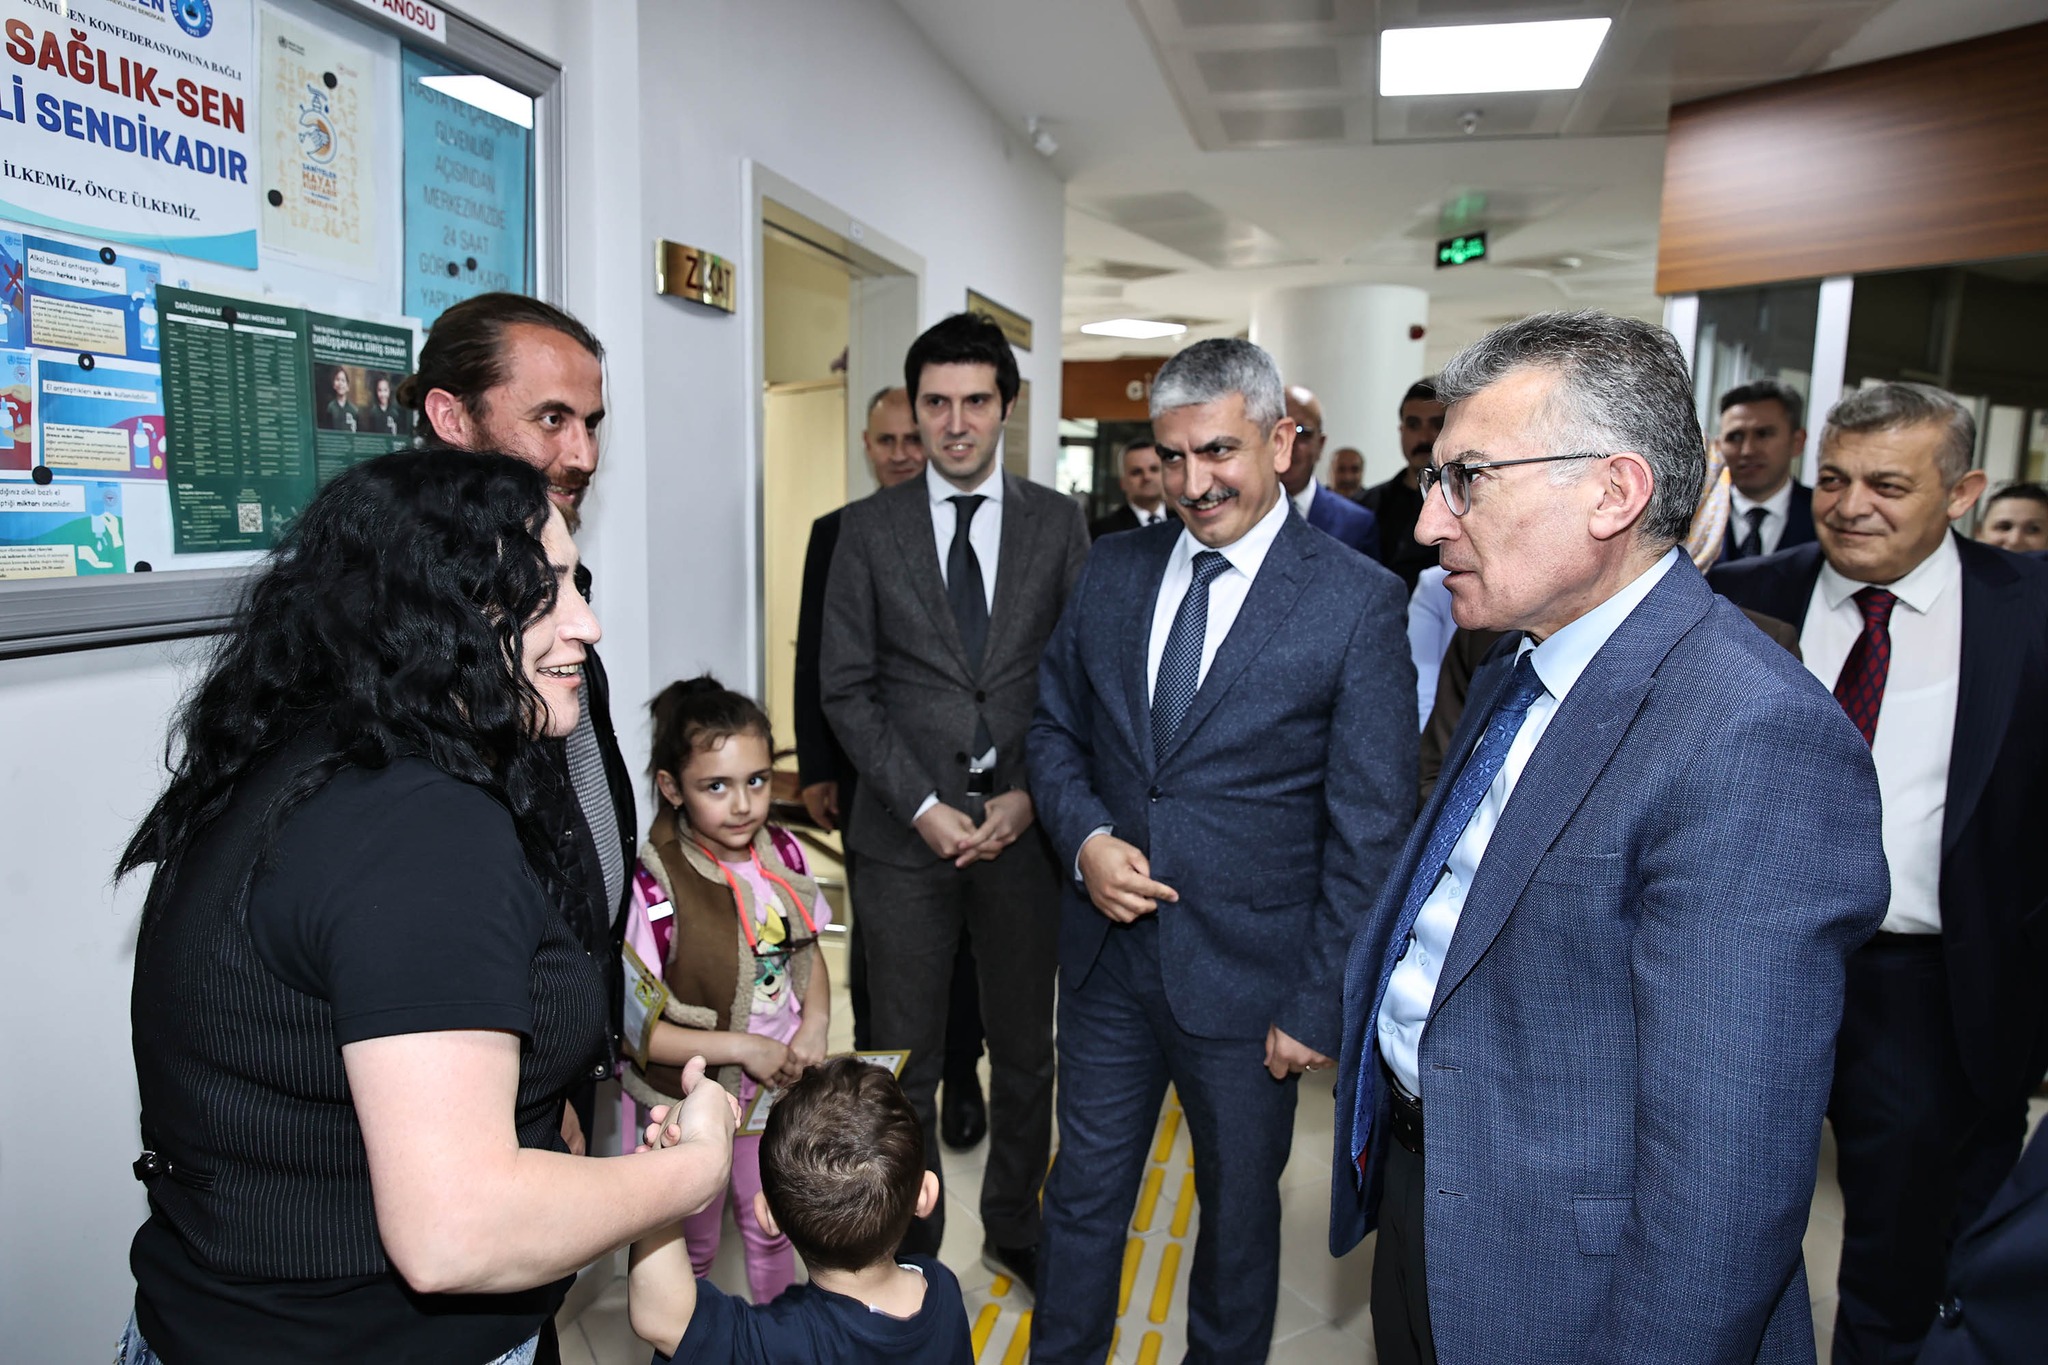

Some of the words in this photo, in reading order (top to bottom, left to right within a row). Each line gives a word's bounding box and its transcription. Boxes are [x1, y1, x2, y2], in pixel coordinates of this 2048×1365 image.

[372, 0, 435, 31] ANOSU
[89, 16, 209, 69] KONFEDERASYONUNA
[211, 61, 242, 81] BAĞLI
[5, 18, 246, 134] SAĞLIK-SEN
[36, 93, 248, 184] SENDİKADIR
[3, 159, 82, 195] İLKEMİZ,
[85, 181, 128, 205] ÖNCE
[443, 225, 457, 247] 24
[460, 230, 489, 255] SAAT
[29, 253, 45, 263] Alkol
[420, 252, 476, 285] GÖRTÜ
[56, 270, 77, 281] herkes
[79, 275, 90, 284] için
[46, 383, 52, 391] El
[37, 488, 53, 496] bazlı
